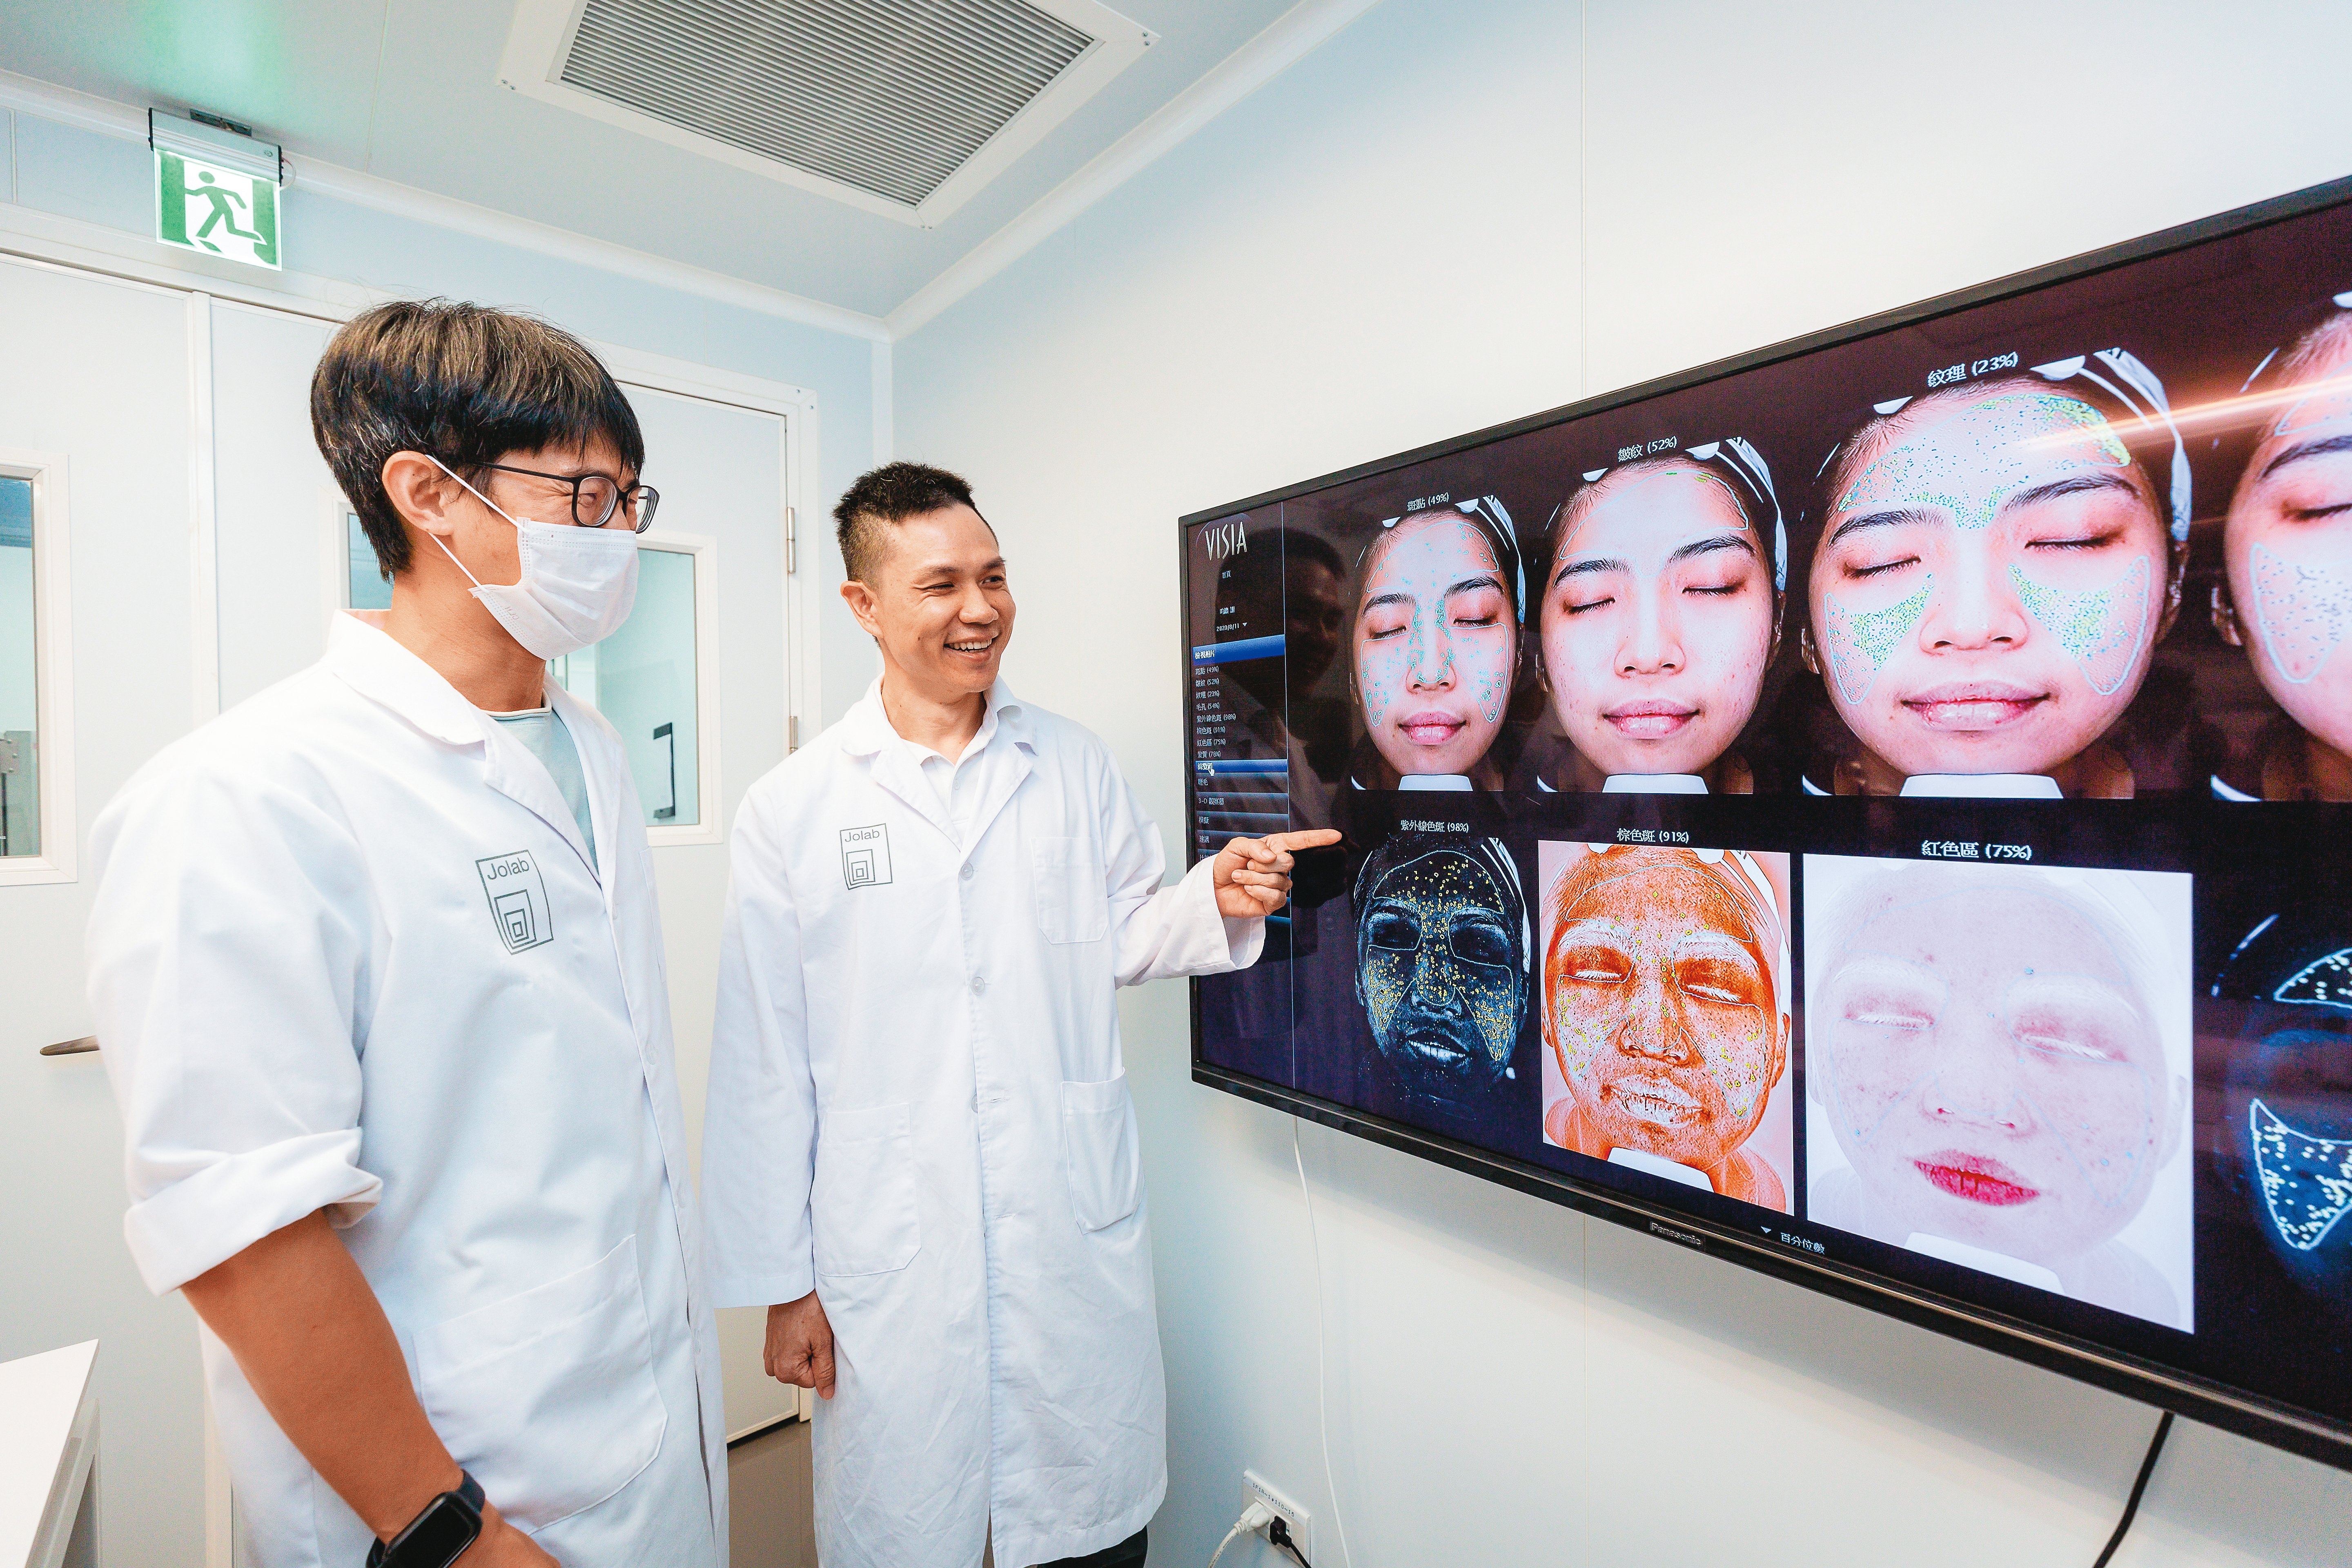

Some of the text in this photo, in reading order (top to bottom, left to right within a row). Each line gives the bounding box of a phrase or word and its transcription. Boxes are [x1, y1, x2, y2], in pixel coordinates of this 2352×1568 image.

[1927, 351, 2018, 388] 紋理 (23%)
[1618, 435, 1677, 462] 皺紋 (52%)
[1407, 492, 1449, 511] 斑點 (49%)
[1205, 521, 1247, 561] VISIA
[1222, 570, 1231, 579] 首頁
[1216, 623, 1239, 631] 2020/8/11
[1195, 650, 1215, 659] 檢視相片
[1207, 666, 1219, 674] (49%)
[1207, 690, 1220, 698] (23%)
[1401, 820, 1469, 833] 紫外線色斑 (98%)
[845, 829, 880, 842] Jolab
[1617, 828, 1689, 844] 棕色斑 (91%)
[1921, 840, 2032, 861] 紅色區 (75%)
[487, 857, 530, 880] Jolab
[1650, 1222, 1702, 1245] Panasonic
[1780, 1232, 1825, 1255] 百分位數
